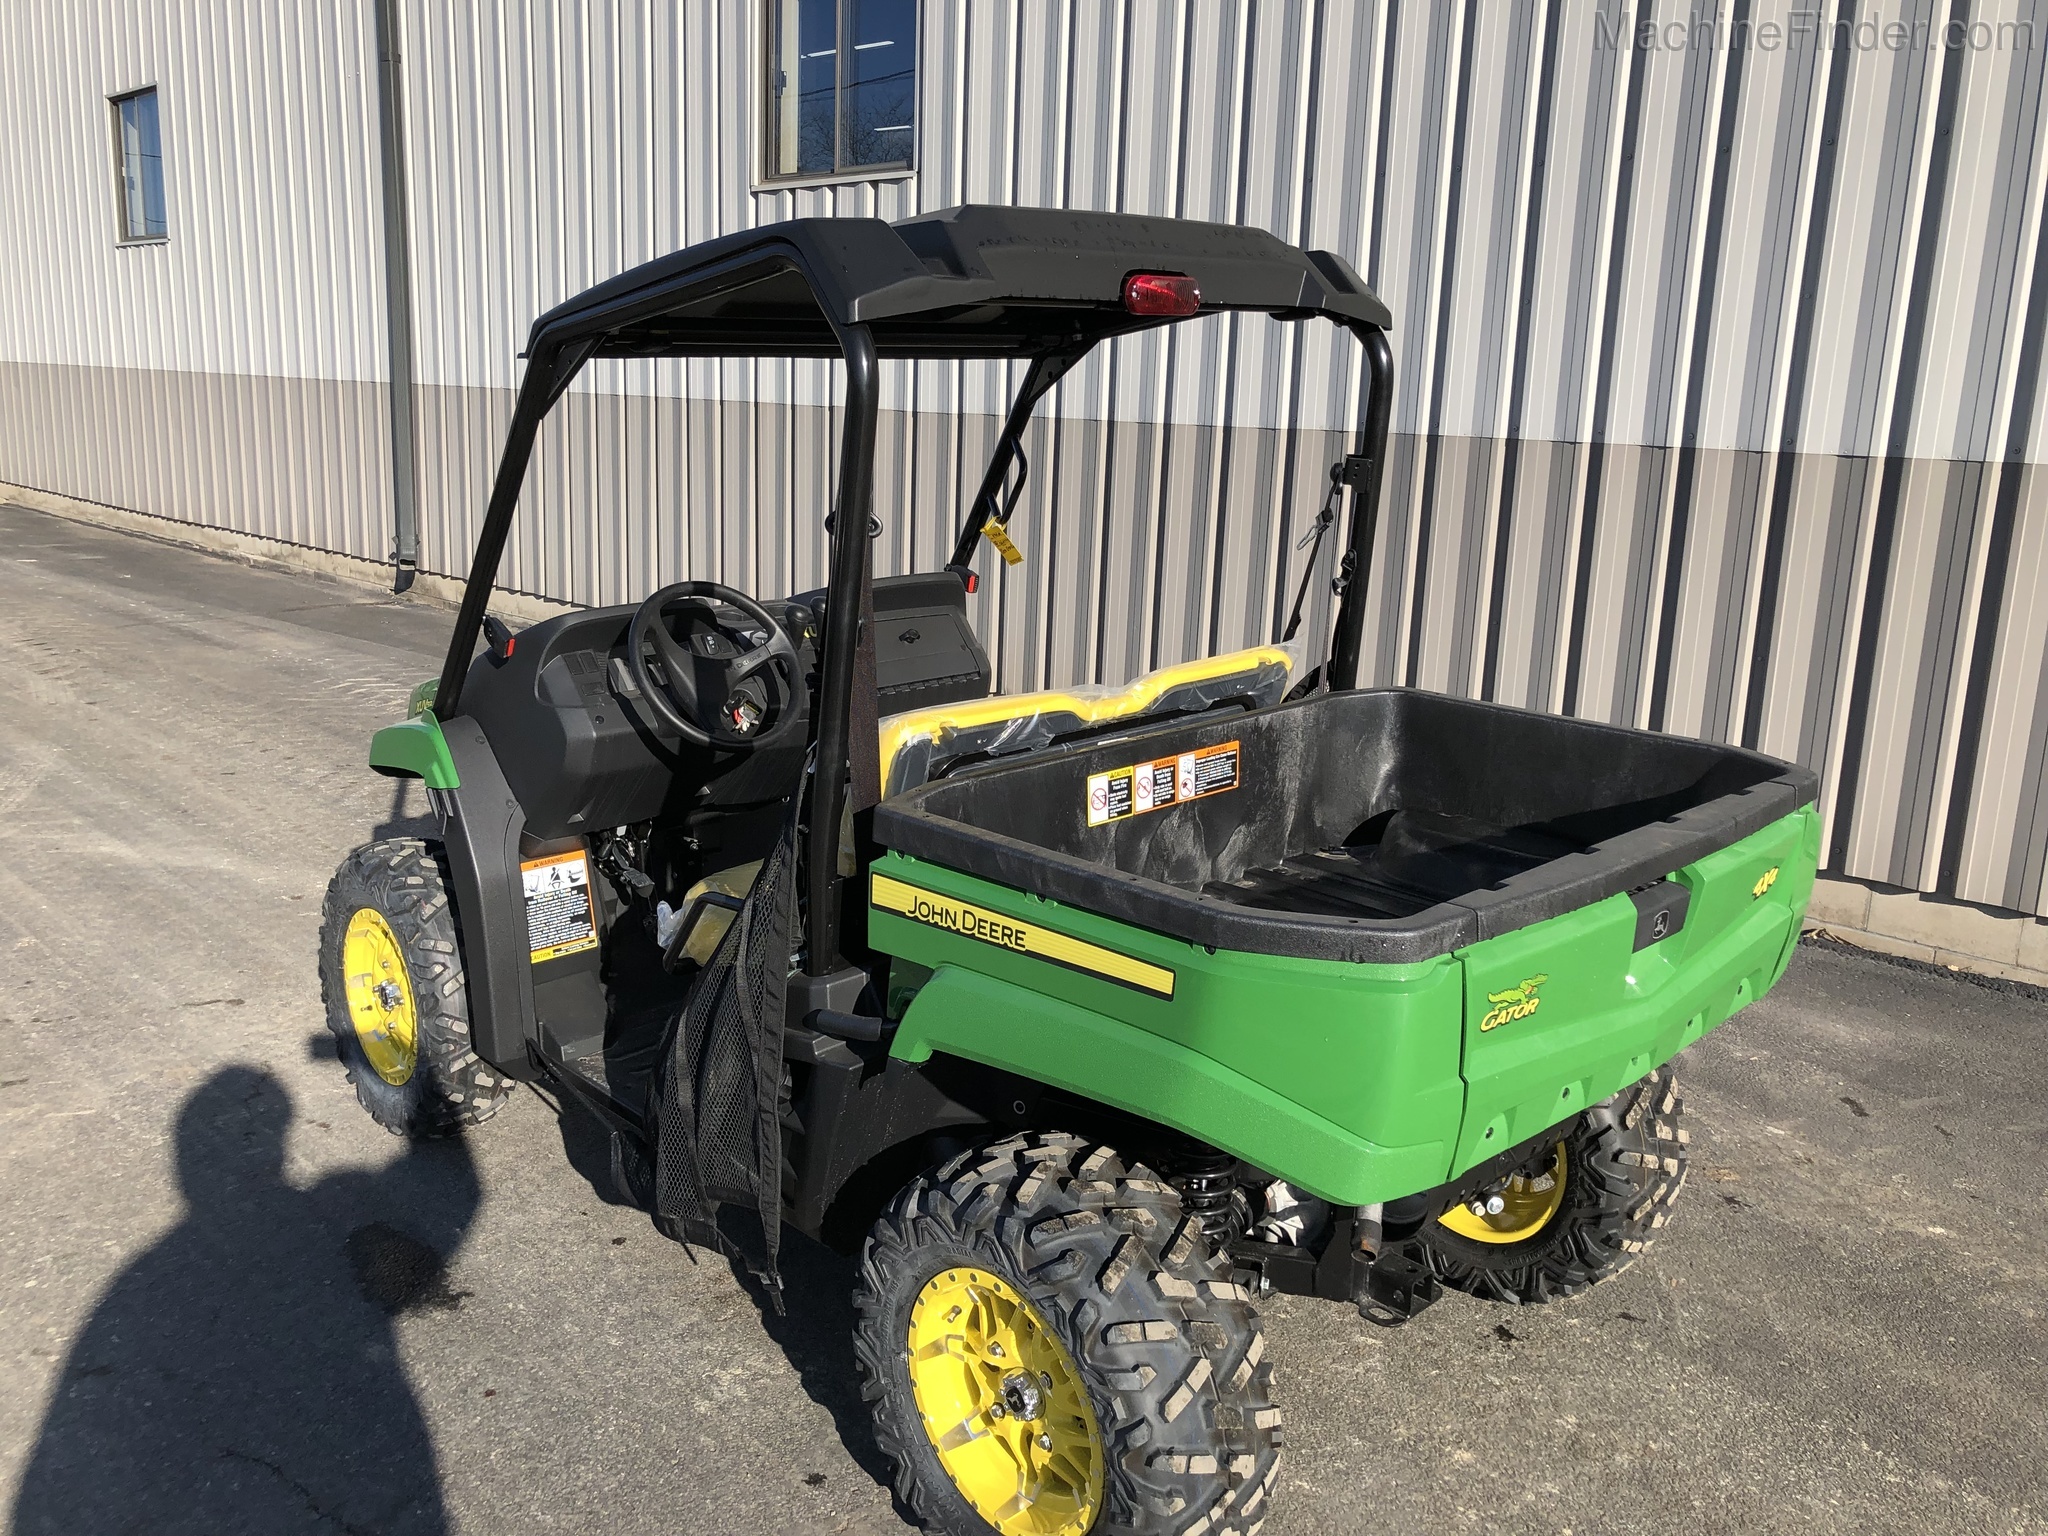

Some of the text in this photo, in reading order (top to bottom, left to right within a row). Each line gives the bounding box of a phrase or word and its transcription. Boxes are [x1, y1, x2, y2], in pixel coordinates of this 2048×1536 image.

[1158, 757, 1175, 766] WARNING
[1115, 768, 1131, 778] CAUTION
[540, 856, 564, 866] WARNING
[907, 895, 1027, 949] JOHN DEERE
[1480, 997, 1541, 1034] GATOR
